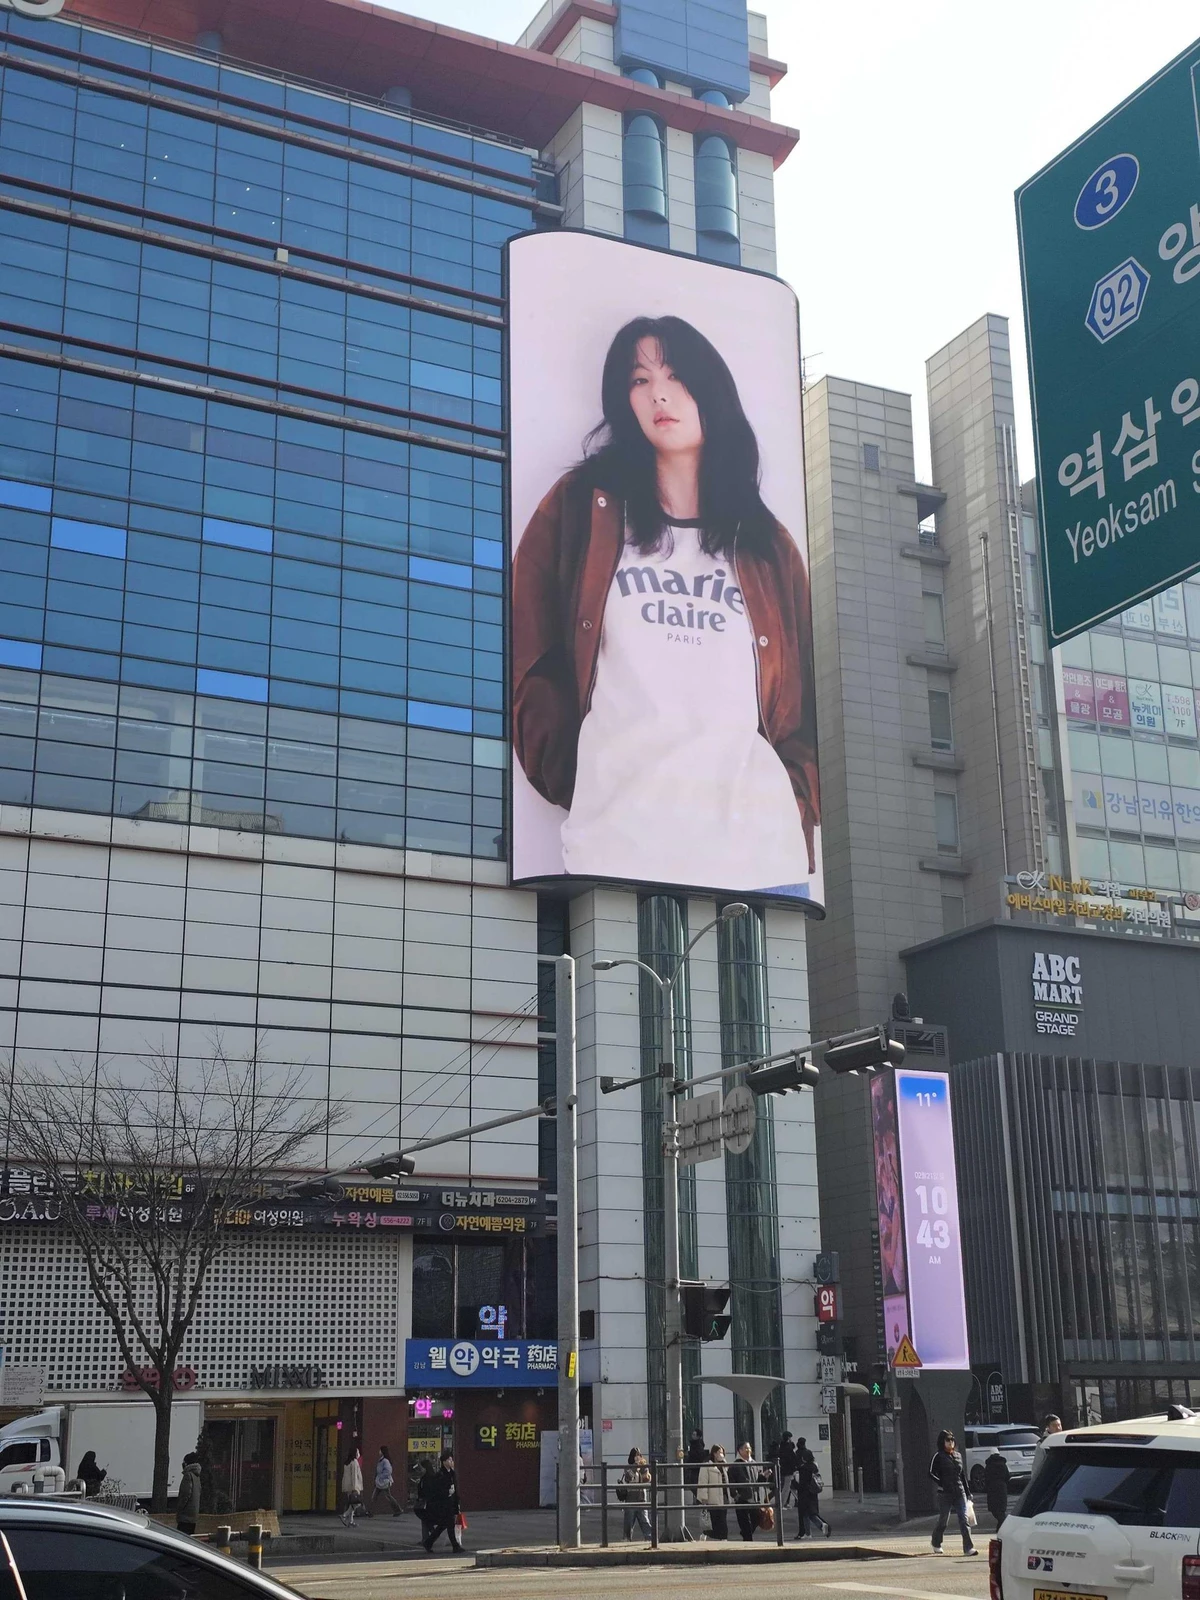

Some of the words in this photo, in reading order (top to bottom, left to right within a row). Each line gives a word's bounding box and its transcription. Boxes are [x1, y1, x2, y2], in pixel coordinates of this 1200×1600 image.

[1095, 169, 1119, 215] 3
[1100, 273, 1135, 327] 92
[1065, 478, 1177, 564] Yeoksam
[615, 566, 744, 615] marie
[641, 600, 726, 632] claire
[667, 632, 702, 646] PARIS
[1132, 701, 1162, 716] 뉴케이
[1136, 714, 1156, 728] 의원
[1175, 719, 1186, 728] 7F
[1097, 880, 1121, 899] 의원
[1126, 906, 1171, 928] 치과의원
[1032, 952, 1081, 984] ABC
[1032, 982, 1083, 1005] MART
[1035, 1011, 1079, 1025] GRAND
[1036, 1023, 1076, 1036] STAGE
[441, 1190, 497, 1207] 더뉴치과
[915, 1185, 948, 1215] 10
[916, 1219, 950, 1249] 43
[928, 1256, 941, 1265] AM
[820, 1289, 834, 1318] 약
[479, 1305, 508, 1339] 약
[527, 1344, 558, 1363] 药店
[527, 1362, 558, 1370] PHARMACY
[415, 1398, 432, 1418] 약
[479, 1425, 498, 1447] 약
[505, 1422, 536, 1440] 药店
[1029, 1548, 1087, 1559] TORRES
